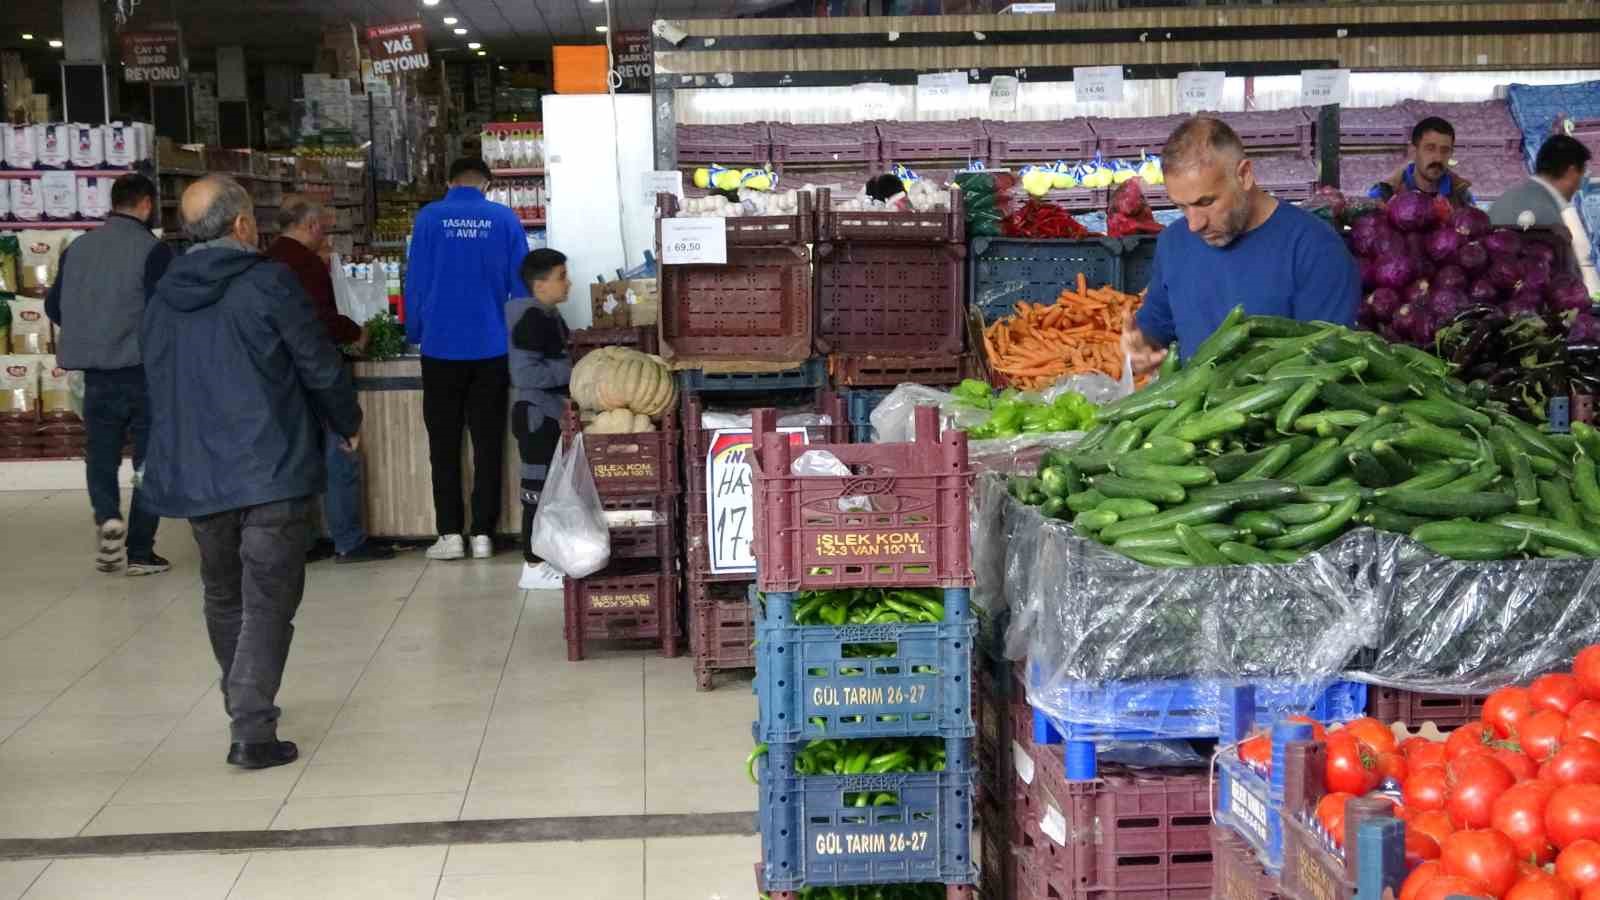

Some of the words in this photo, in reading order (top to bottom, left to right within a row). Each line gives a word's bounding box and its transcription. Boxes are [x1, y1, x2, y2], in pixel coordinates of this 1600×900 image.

[382, 35, 413, 54] YAĞ
[373, 52, 430, 75] REYONU
[125, 66, 180, 81] REYONU
[456, 228, 478, 239] AVM
[717, 466, 753, 498] HA
[876, 532, 924, 545] KOM.
[815, 545, 848, 556] 1-2-3
[850, 545, 880, 556] VAN
[883, 544, 907, 555] 100
[910, 543, 927, 554] TL
[813, 684, 840, 706] GÜL
[843, 687, 884, 705] TARIM
[887, 684, 928, 705] 26-27
[815, 832, 843, 855] GÜL
[846, 833, 886, 854] TARIM
[889, 831, 928, 853] 26-27
